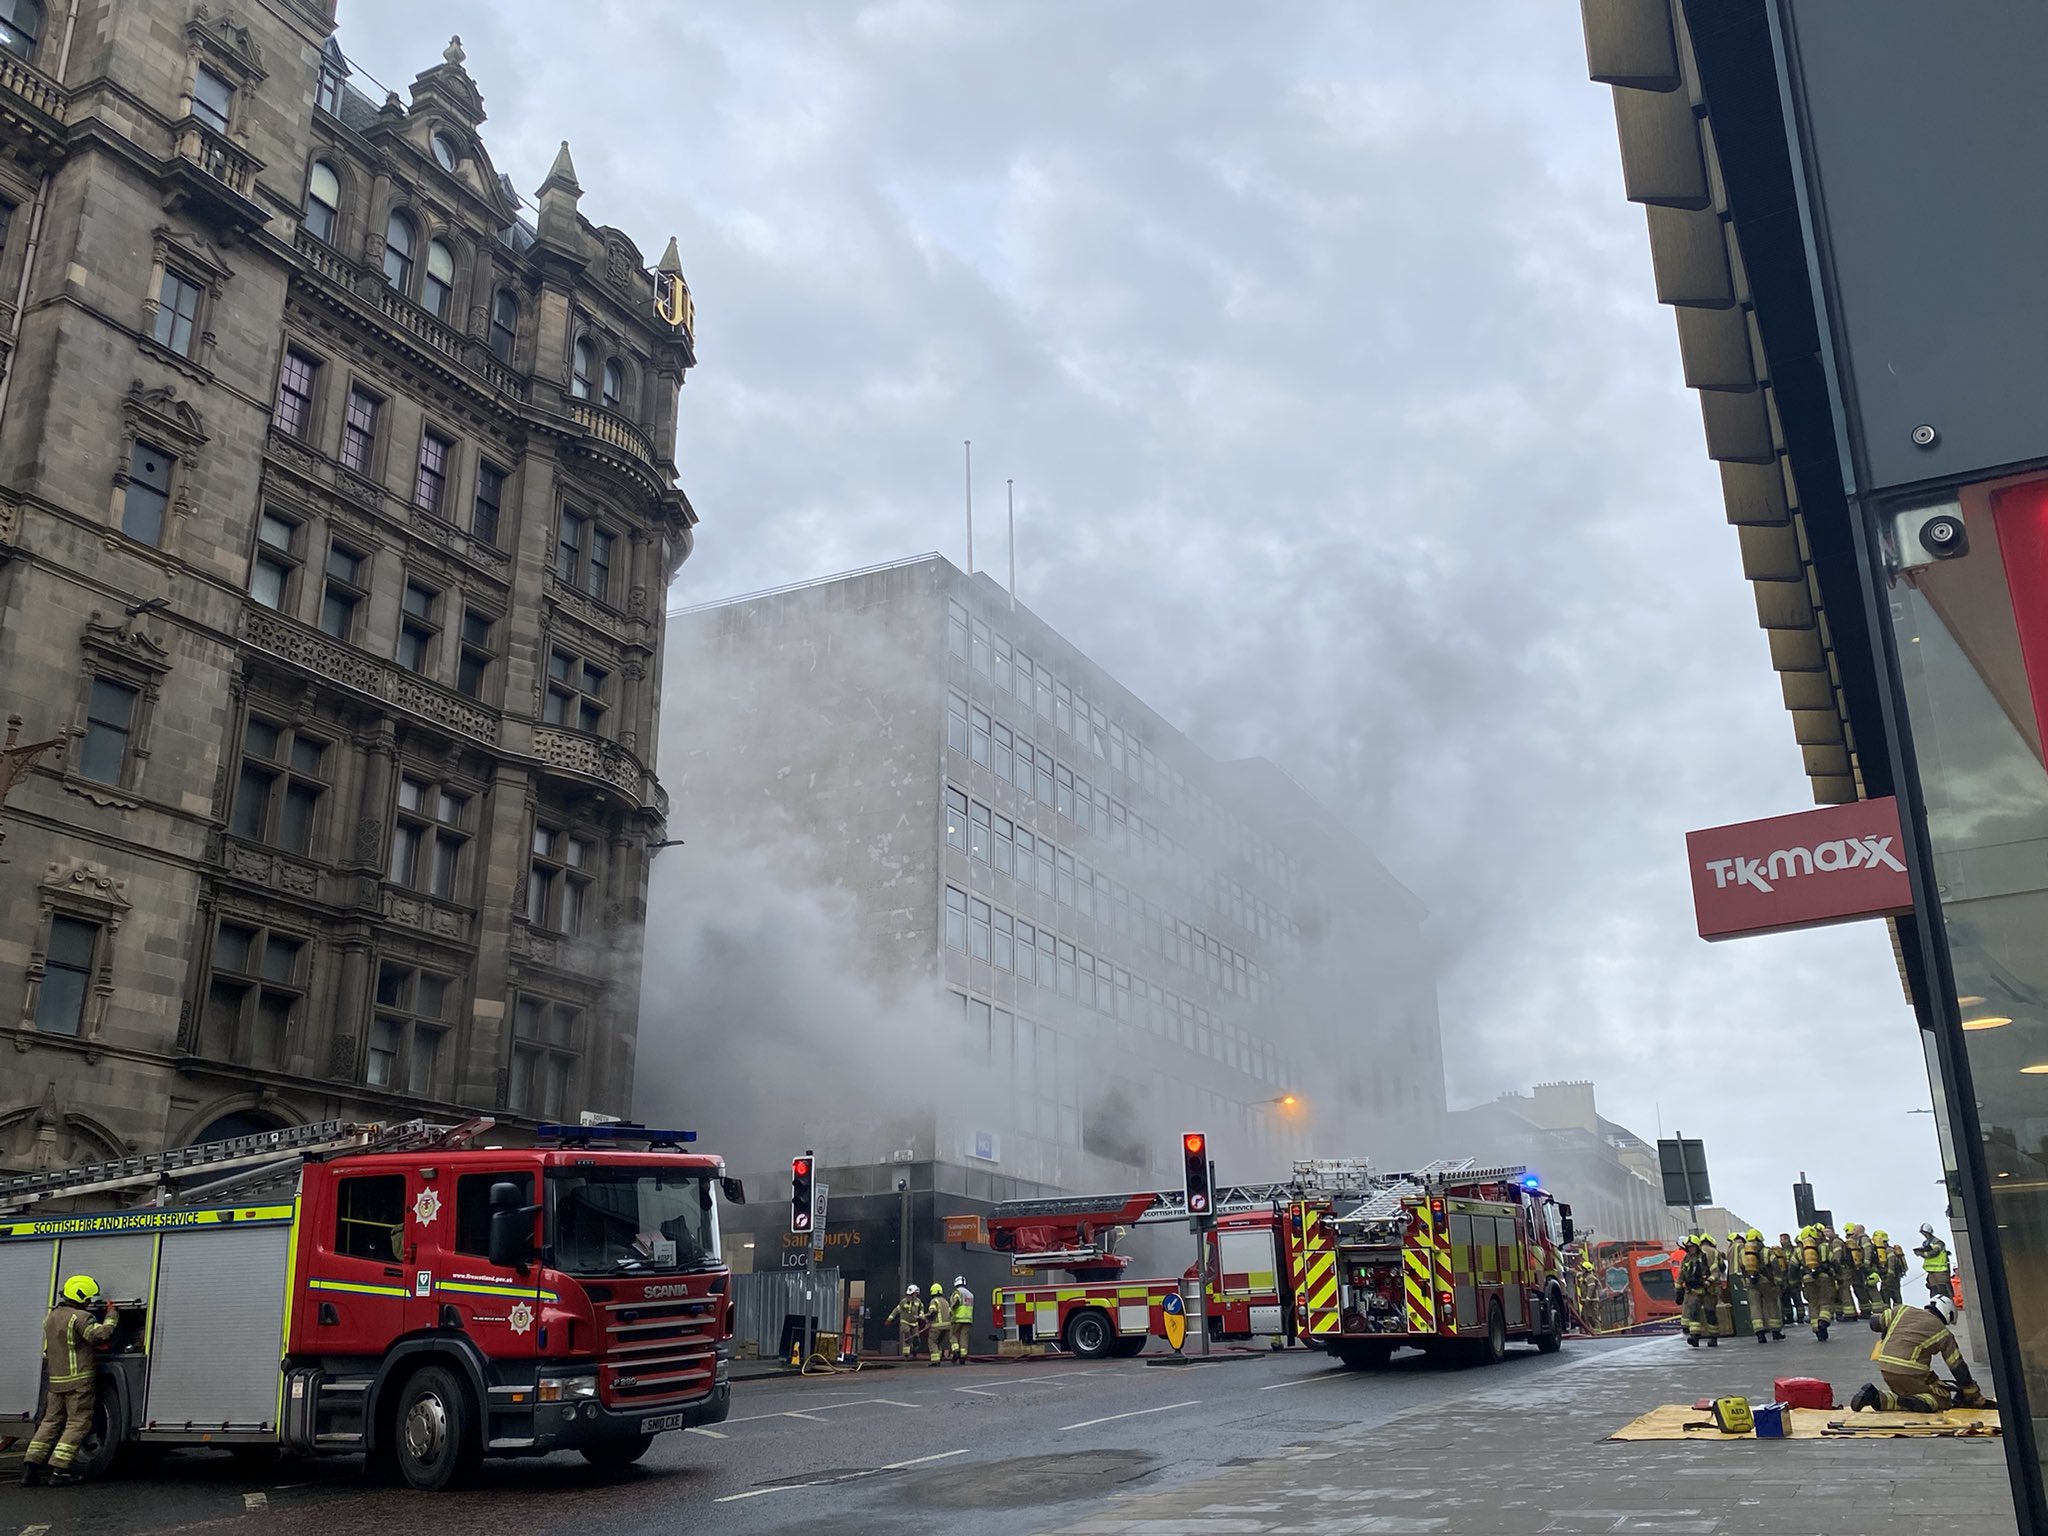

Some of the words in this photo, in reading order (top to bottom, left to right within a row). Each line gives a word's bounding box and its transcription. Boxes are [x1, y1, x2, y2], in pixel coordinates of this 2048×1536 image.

[1228, 1204, 1254, 1212] SERVICE
[33, 1219, 76, 1234] SCOTTISH
[79, 1218, 98, 1231] FIRE
[99, 1216, 120, 1229] AND
[122, 1214, 158, 1229] RESCUE
[159, 1211, 199, 1226] SERVICE
[643, 1284, 689, 1299] SCANIA
